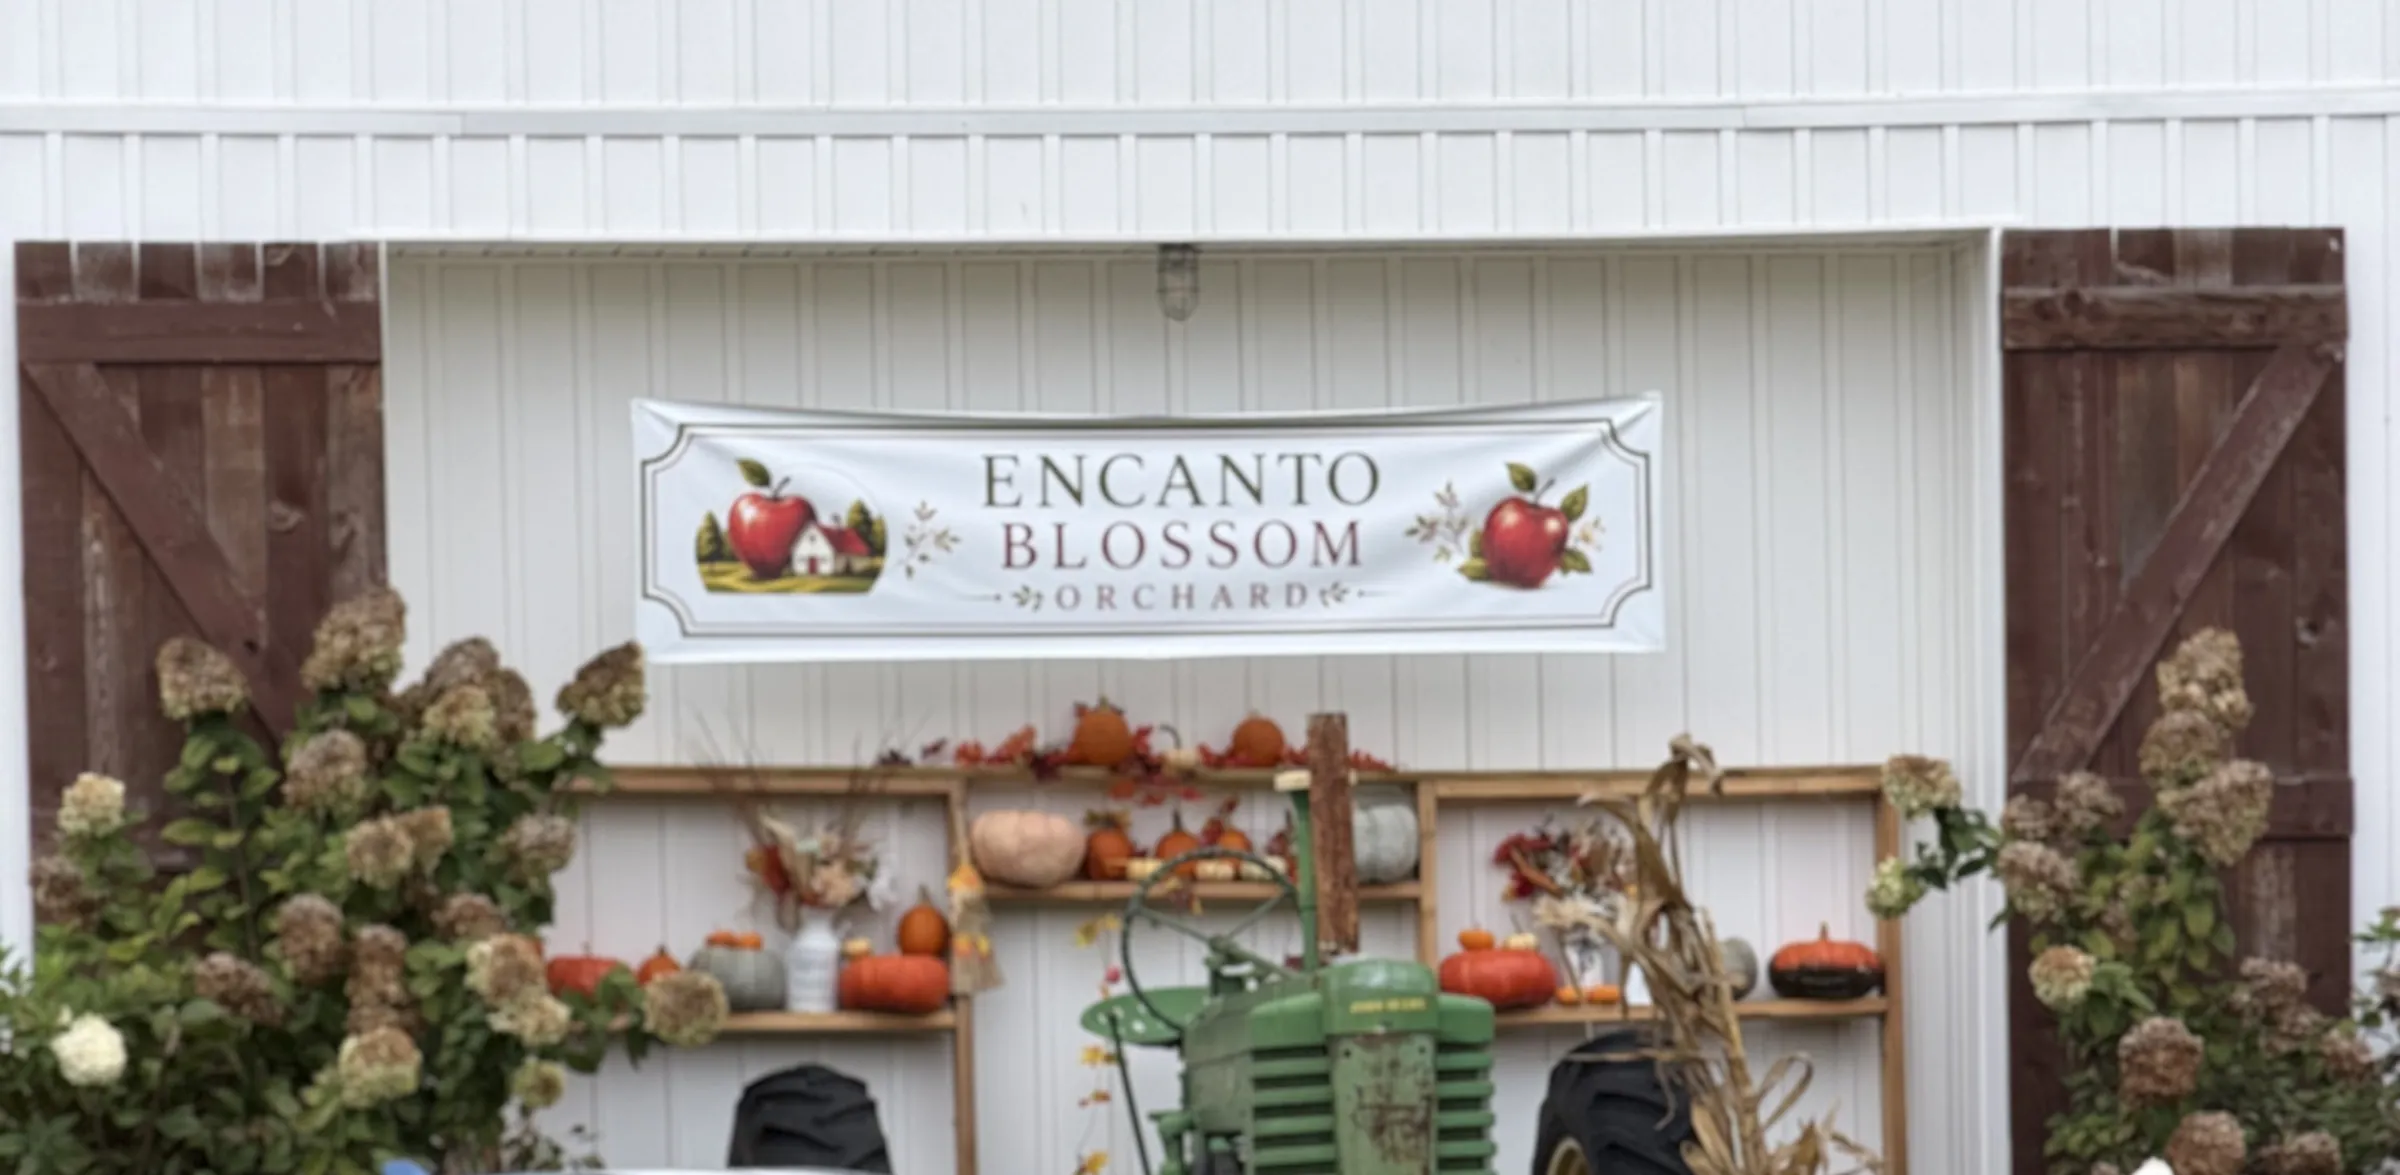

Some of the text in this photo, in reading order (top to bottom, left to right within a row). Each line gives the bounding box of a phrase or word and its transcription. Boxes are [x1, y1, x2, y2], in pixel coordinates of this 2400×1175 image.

[982, 451, 1380, 508] ENCANTO
[1001, 519, 1362, 570] BLOSSOM
[1055, 583, 1308, 611] ORCHARD
